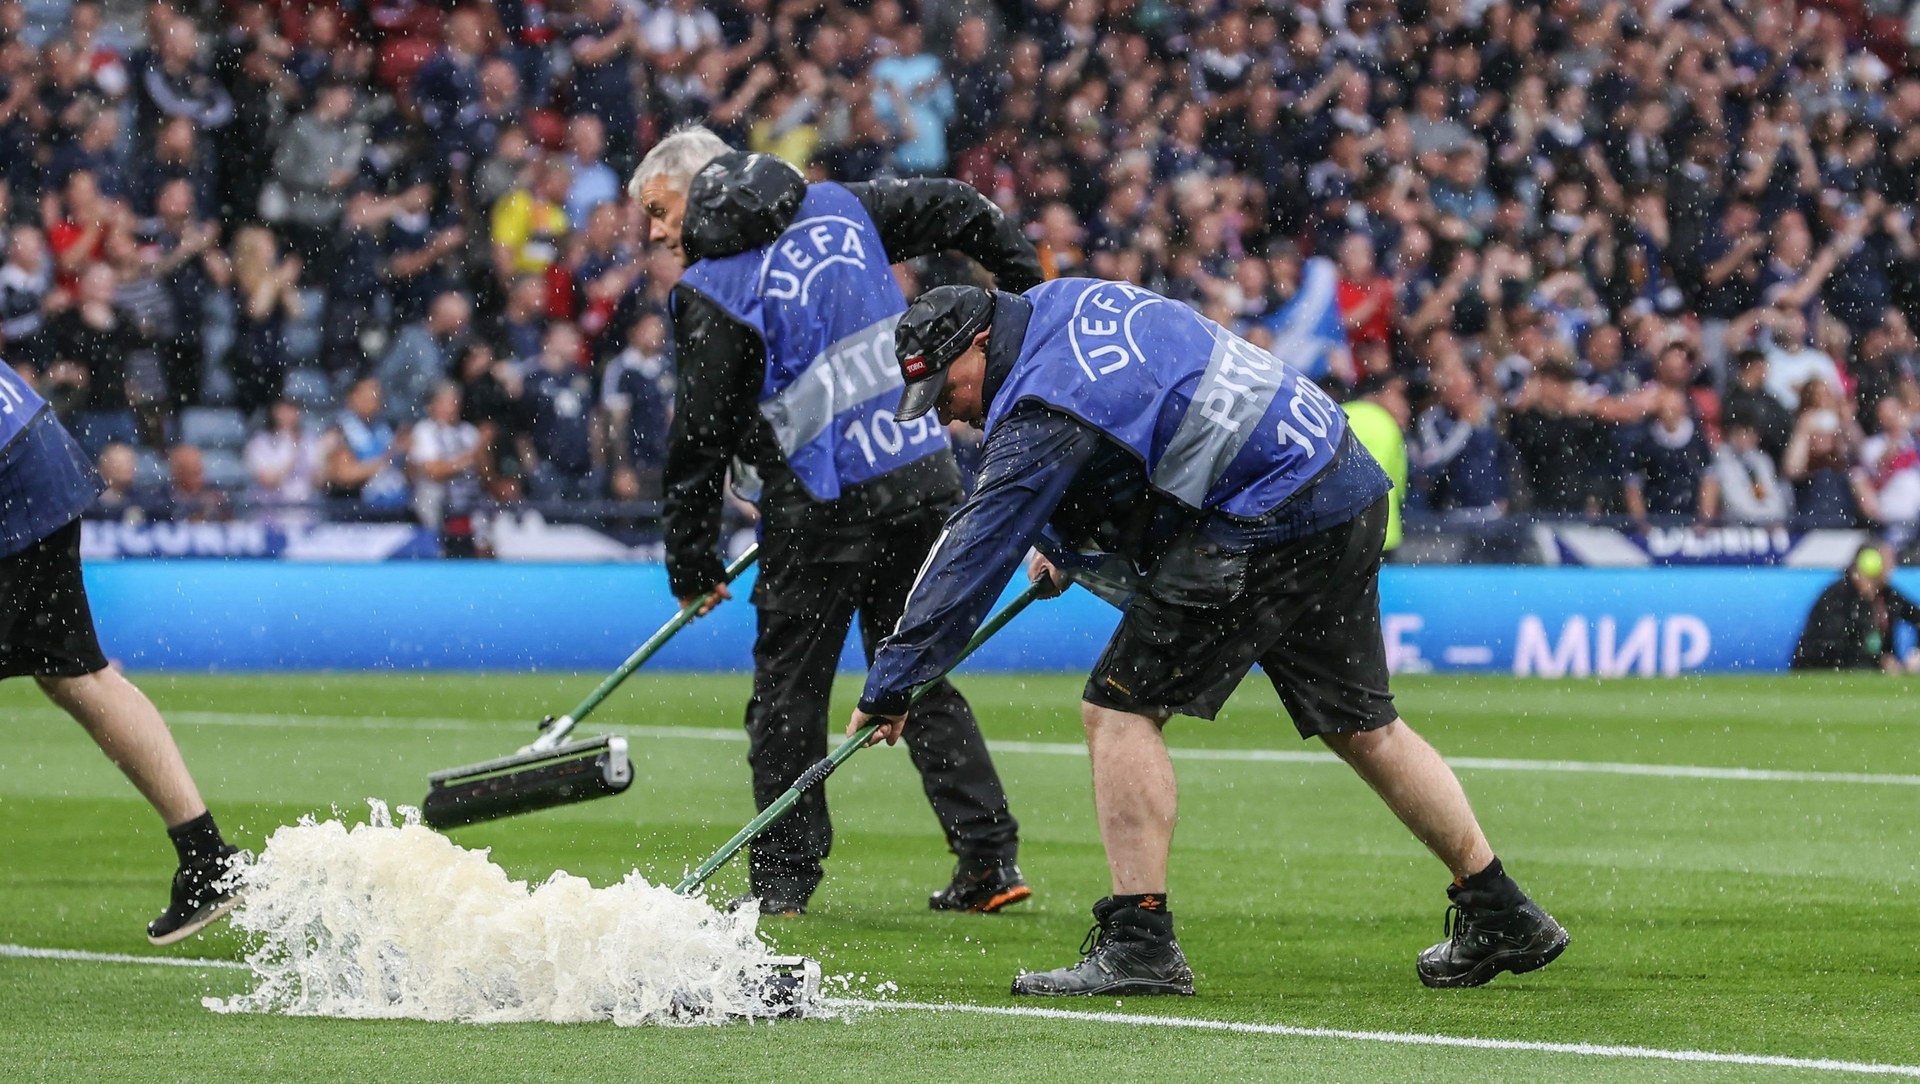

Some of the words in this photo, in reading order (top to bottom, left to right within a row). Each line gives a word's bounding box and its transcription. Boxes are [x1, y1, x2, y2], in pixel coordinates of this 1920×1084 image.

[766, 225, 866, 300] UEFA
[815, 331, 900, 396] ITC
[1081, 284, 1154, 375] UEFA
[1200, 335, 1273, 431] PITC
[1512, 613, 1712, 680] МИР
